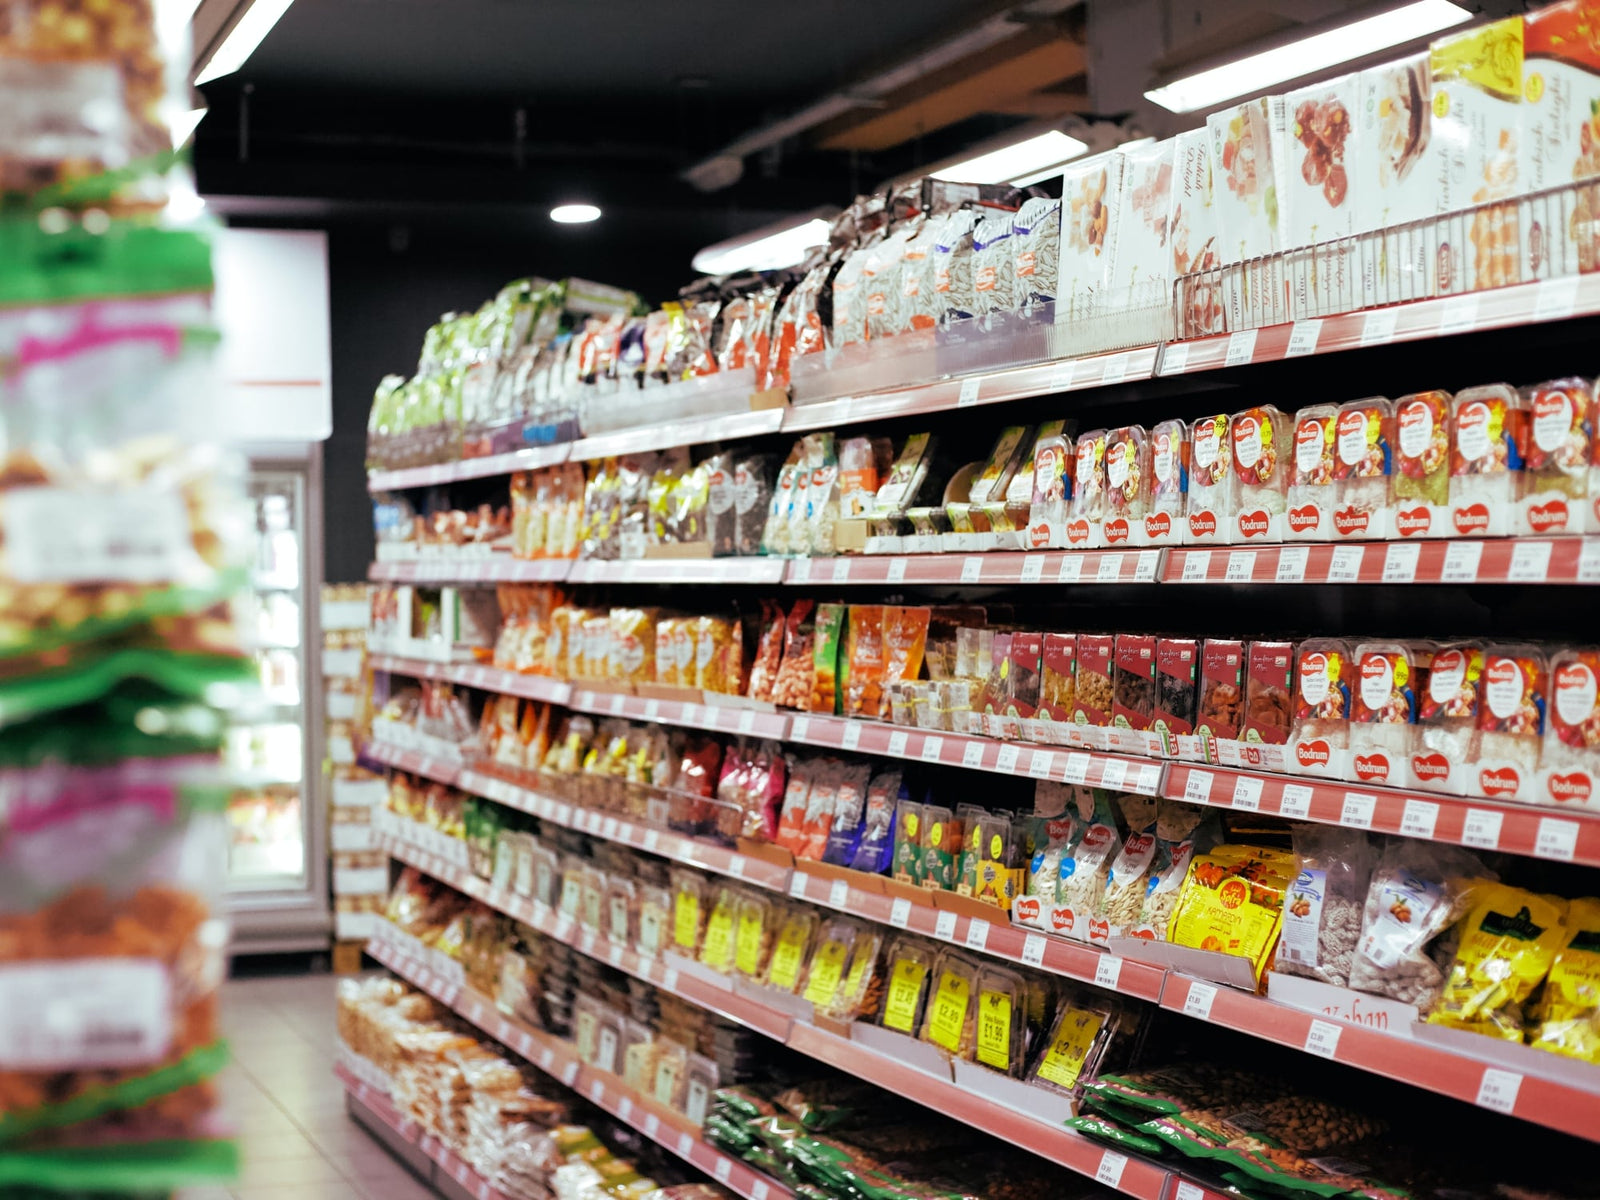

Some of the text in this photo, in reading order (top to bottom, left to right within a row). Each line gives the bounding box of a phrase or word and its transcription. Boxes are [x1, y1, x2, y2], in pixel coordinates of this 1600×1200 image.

[1183, 147, 1195, 198] Delight
[1195, 142, 1207, 191] Turkish
[1290, 513, 1318, 526] Bodrum
[1336, 514, 1368, 528] Bodrum
[1398, 515, 1430, 529] Bodrum
[1455, 512, 1489, 526] Bodrum
[1530, 510, 1567, 523] Bodrum
[1104, 525, 1128, 537] Bodrum
[1146, 519, 1171, 532] Bodrum
[1190, 519, 1216, 531] Bodrum
[1240, 519, 1268, 531] Bodrum
[1298, 748, 1328, 760] Bodrum
[1357, 760, 1388, 774] Bodrum
[1414, 761, 1448, 775] Bodrum
[1482, 774, 1517, 789] Bodrum
[1552, 780, 1590, 796] Bodrum
[1052, 913, 1074, 926] Bodrum
